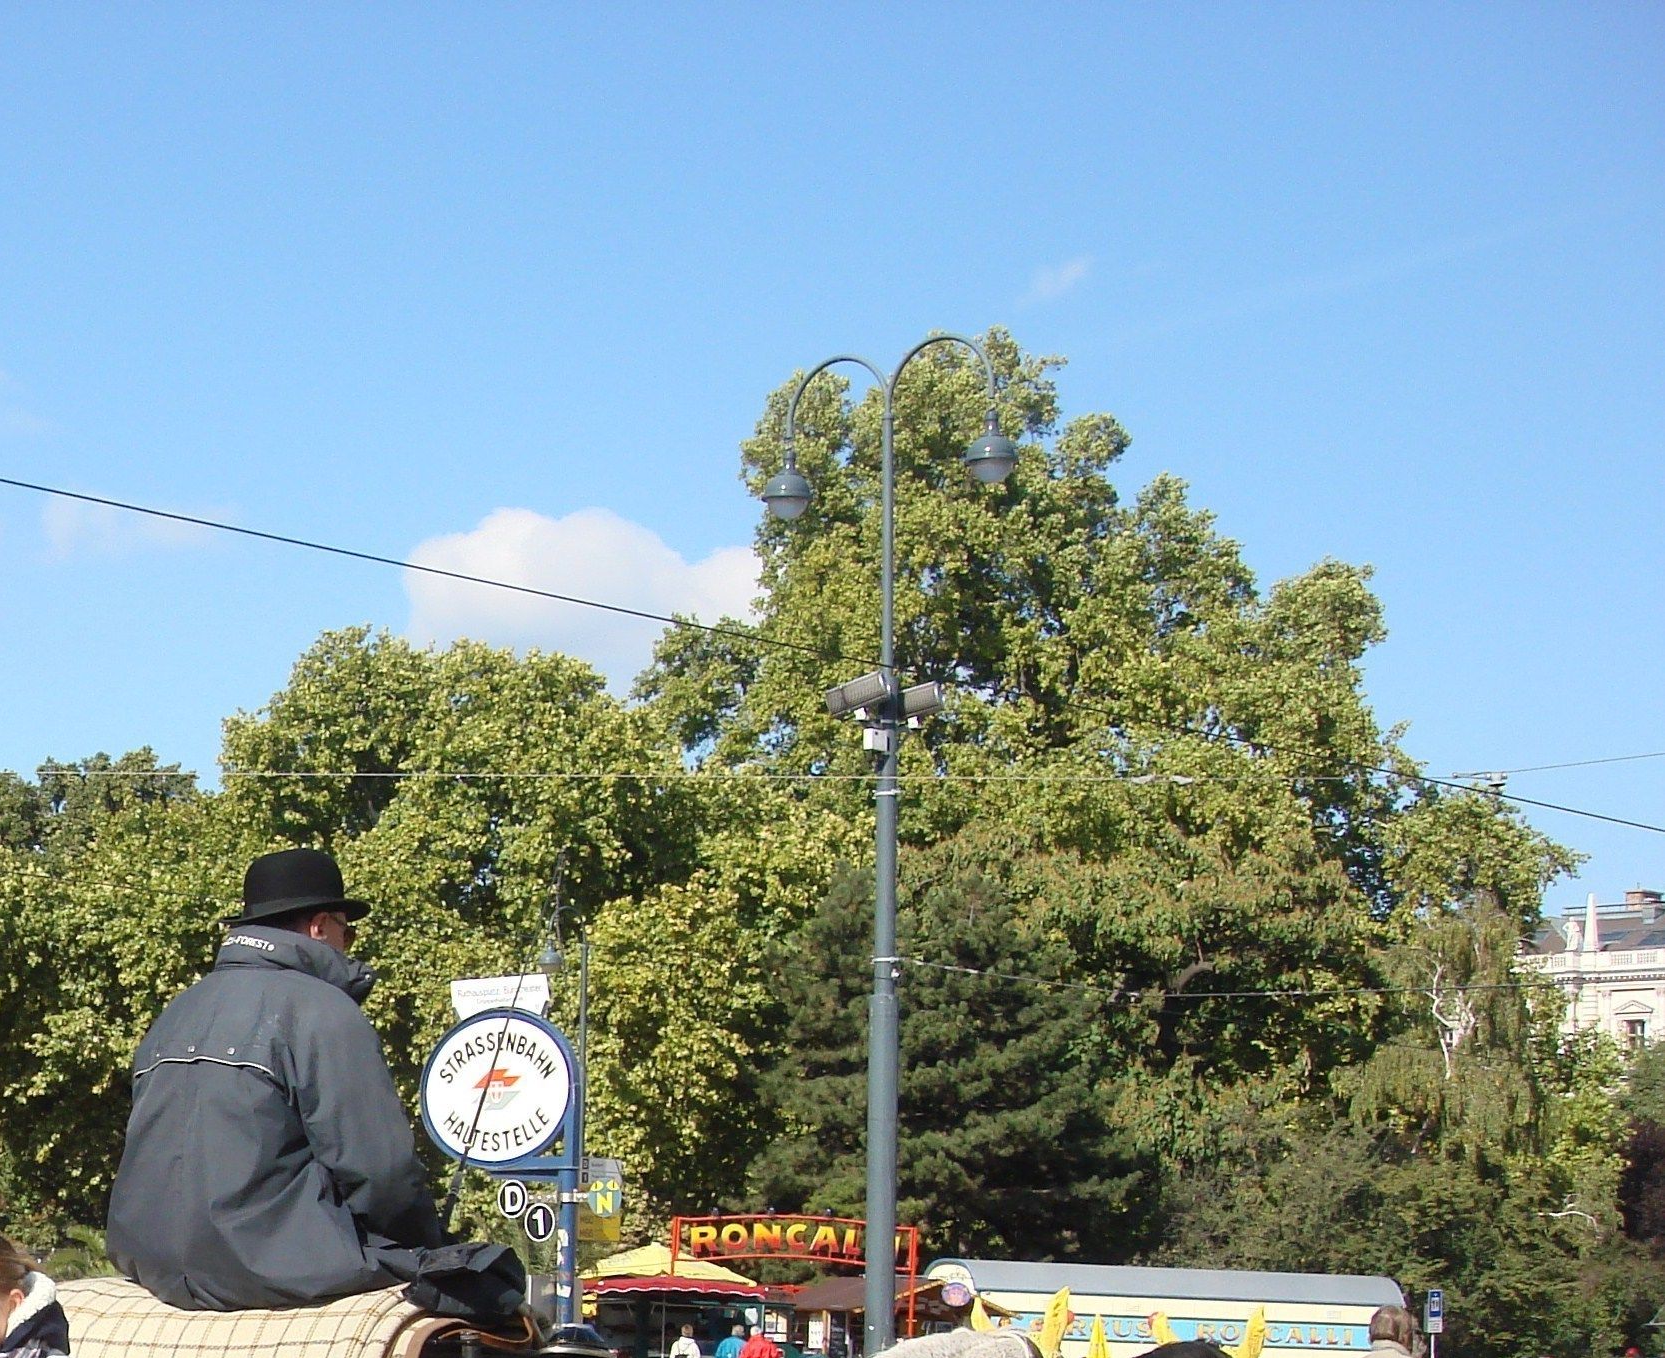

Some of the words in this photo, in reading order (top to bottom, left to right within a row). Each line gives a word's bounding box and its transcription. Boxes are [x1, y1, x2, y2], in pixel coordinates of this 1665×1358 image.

[439, 1031, 557, 1084] STRASSENBAHN
[443, 1107, 550, 1152] HALTESTELLE
[504, 1186, 520, 1211] D
[596, 1191, 613, 1214] N
[532, 1210, 546, 1236] 1
[690, 1223, 901, 1257] RONCALI
[1196, 1321, 1354, 1346] ROCALLI
